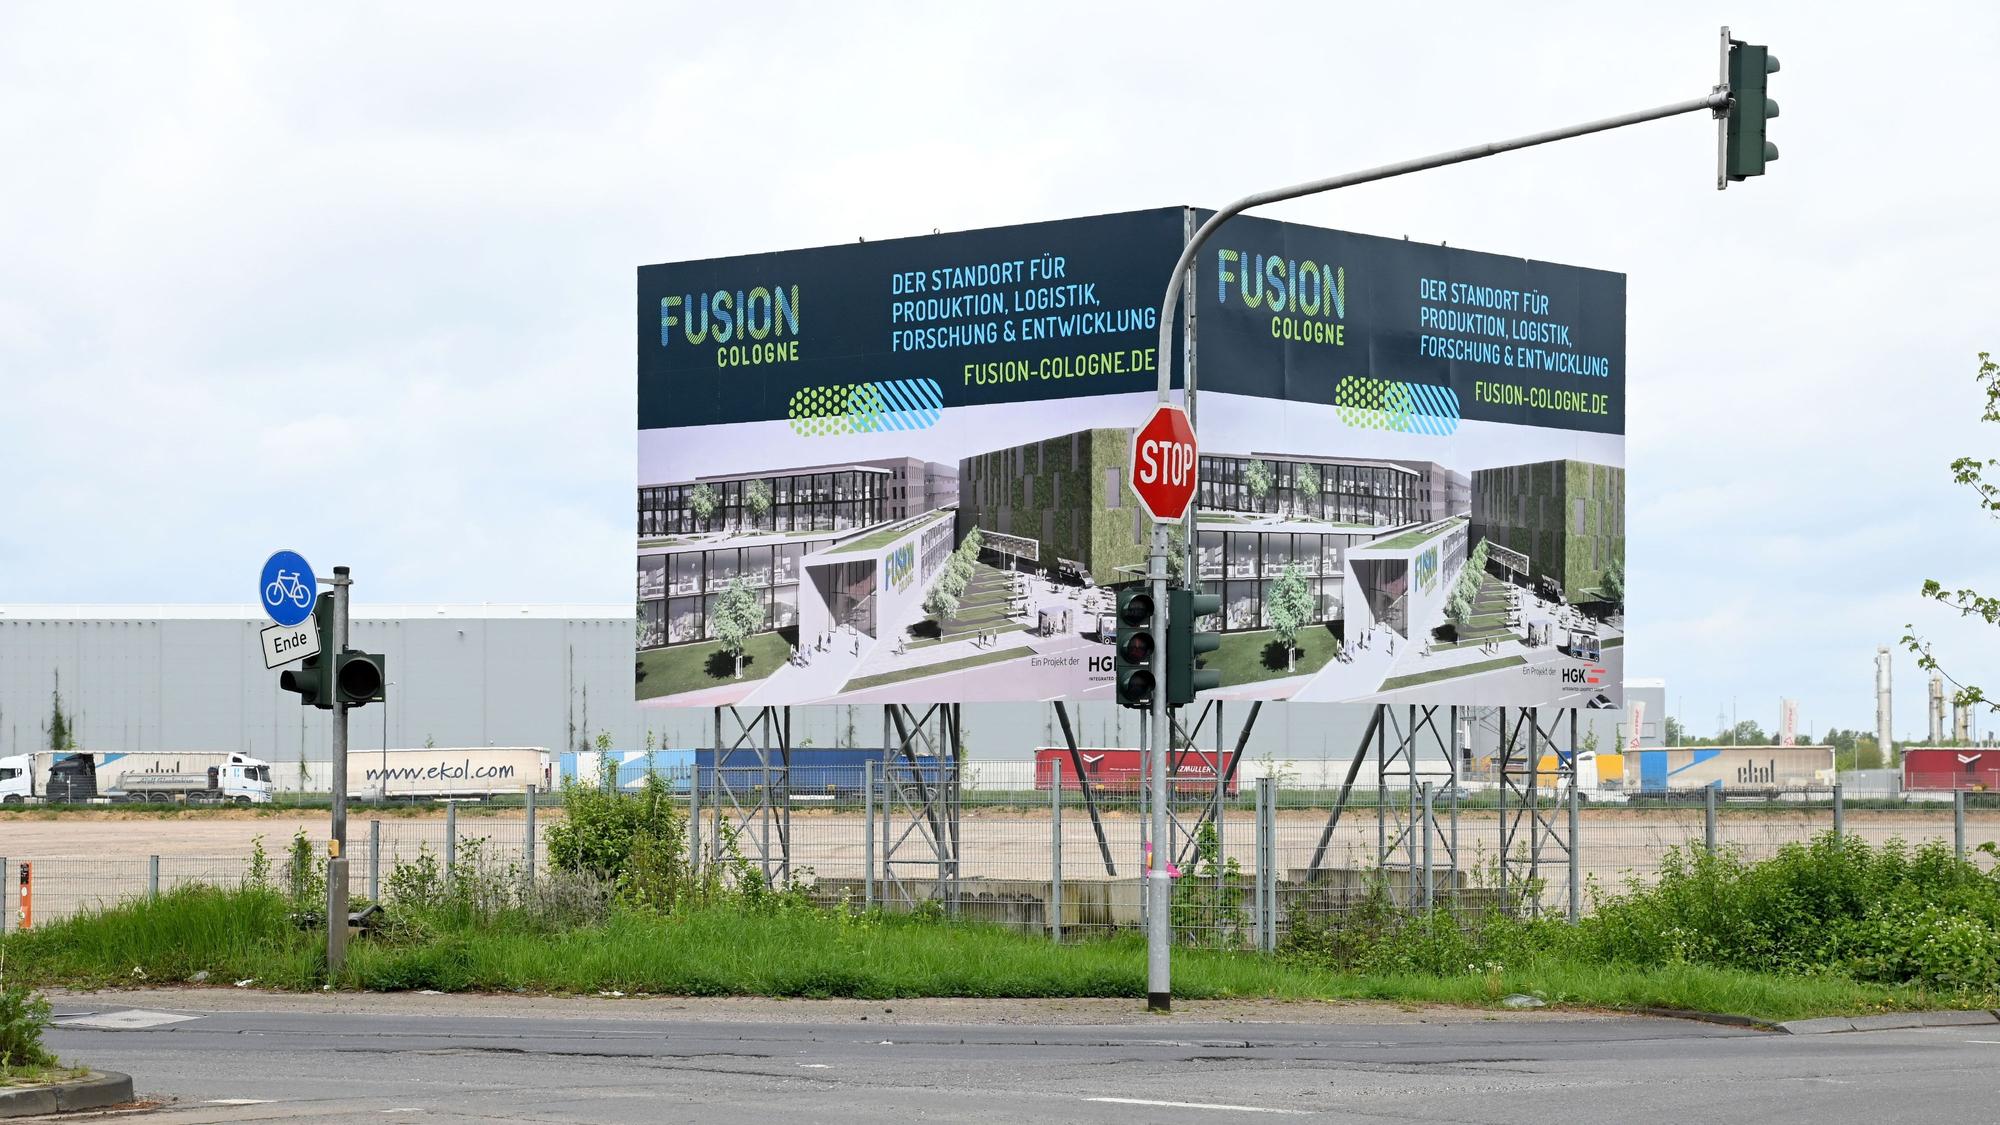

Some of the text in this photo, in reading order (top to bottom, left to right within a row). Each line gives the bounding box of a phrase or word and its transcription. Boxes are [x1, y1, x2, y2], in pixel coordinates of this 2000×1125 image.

[892, 252, 1066, 295] DER STANDORT FÜR
[1218, 248, 1345, 319] FUSION
[892, 282, 1100, 323] PRODUKTION, LOGISTIK,
[1420, 278, 1549, 315] DER STANDORT FÜR
[660, 284, 799, 347] FUSION
[892, 307, 1156, 352] FORSCHUNG & ENTWICKLUNG
[1271, 316, 1345, 346] COLOGNE
[1421, 306, 1573, 348] PRODUKTION, LOGISTIK,
[717, 340, 799, 368] COLOGNE
[964, 348, 1156, 386] FUSION-COLOGNE.DE
[1420, 335, 1609, 377] FORSCHUNG & ENTWICKLUNG
[1475, 381, 1609, 415] FUSION-COLOGNE.DE
[1140, 439, 1193, 487] STOP
[274, 631, 307, 653] Ende
[1031, 656, 1079, 667] Ein Projekt der
[1522, 667, 1530, 675] Ein
[1531, 666, 1548, 676] Projekt
[1562, 668, 1586, 683] HGK
[366, 758, 514, 781] www.ekol.com
